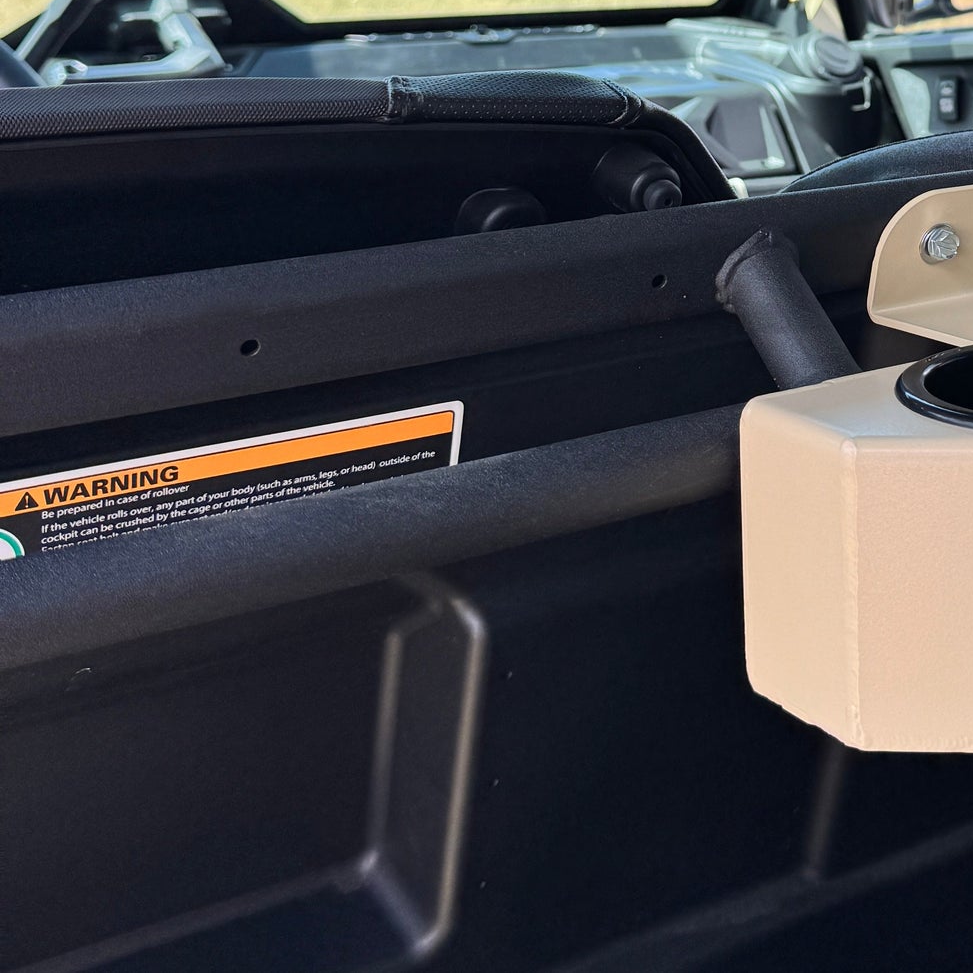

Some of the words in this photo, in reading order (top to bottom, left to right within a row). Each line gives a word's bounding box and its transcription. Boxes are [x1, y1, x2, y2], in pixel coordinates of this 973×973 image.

[41, 524, 50, 534] If
[50, 522, 68, 532] the
[69, 515, 105, 528] vehicle
[107, 510, 128, 521] rolls
[130, 505, 154, 517] over,
[156, 501, 174, 514] any
[175, 496, 195, 509] part
[196, 493, 208, 503] of
[208, 491, 231, 502] your
[231, 485, 256, 497] body
[257, 479, 281, 492] (such
[282, 477, 293, 486] as
[294, 473, 318, 484] arms,
[319, 470, 339, 480] legs,
[340, 466, 351, 475] or
[352, 461, 376, 473] head)
[379, 454, 411, 467] outside
[411, 450, 422, 461] of
[421, 450, 436, 459] the
[41, 511, 55, 520] Be
[57, 499, 103, 521] prepared
[105, 498, 115, 507] in
[116, 494, 139, 505] case
[140, 490, 152, 500] of
[152, 484, 190, 498] rollover
[41, 530, 79, 544] cockpit
[80, 527, 99, 536] can
[100, 522, 114, 532] be
[115, 513, 155, 529] crushed
[156, 510, 169, 522] by
[170, 507, 187, 518] the
[187, 502, 211, 516] cage
[212, 500, 223, 510] or
[223, 496, 249, 508] other
[250, 491, 274, 504] parts
[275, 487, 287, 498] of
[286, 484, 302, 495] the
[303, 479, 336, 492] vehicle.
[43, 466, 179, 505] WARNING
